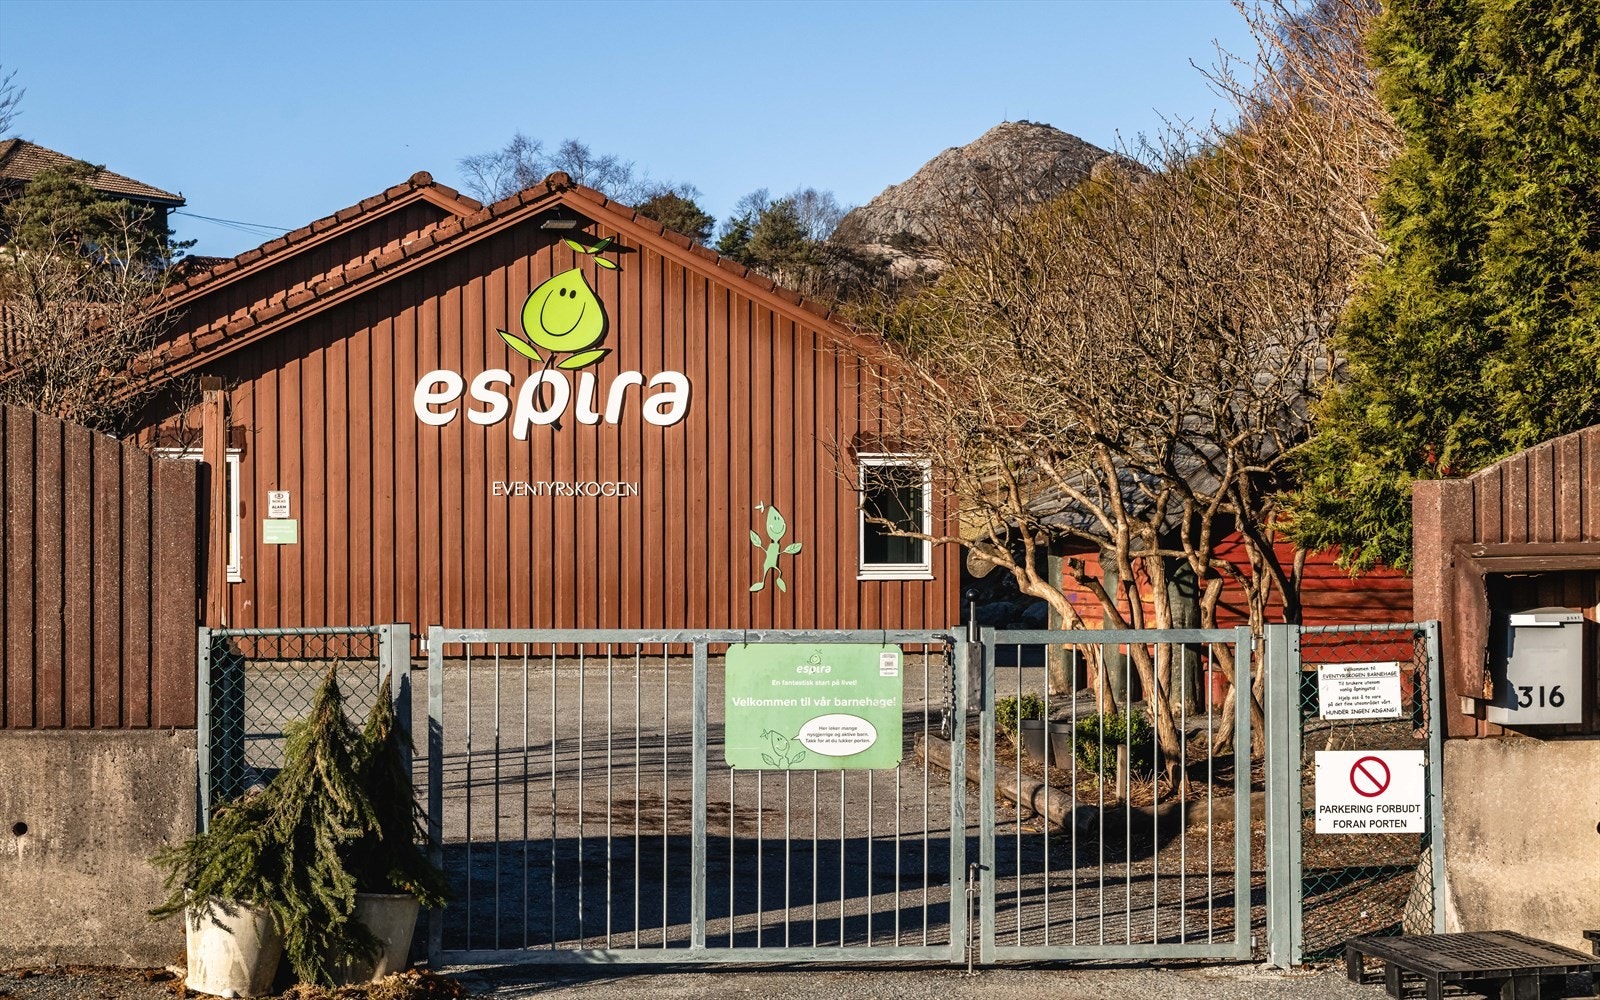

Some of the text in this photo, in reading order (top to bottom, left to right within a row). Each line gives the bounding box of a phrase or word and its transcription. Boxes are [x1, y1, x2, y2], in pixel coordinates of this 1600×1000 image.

[413, 368, 690, 441] espira
[492, 481, 638, 496] EVENTYRSKOGEN
[796, 665, 832, 674] espira
[831, 679, 840, 687] på
[1518, 685, 1565, 708] 316
[732, 696, 896, 709] Velkommen til vår barnehage!
[1319, 804, 1421, 813] PARKERING FORBUDT
[1333, 819, 1407, 828] FORAN PORTEN
